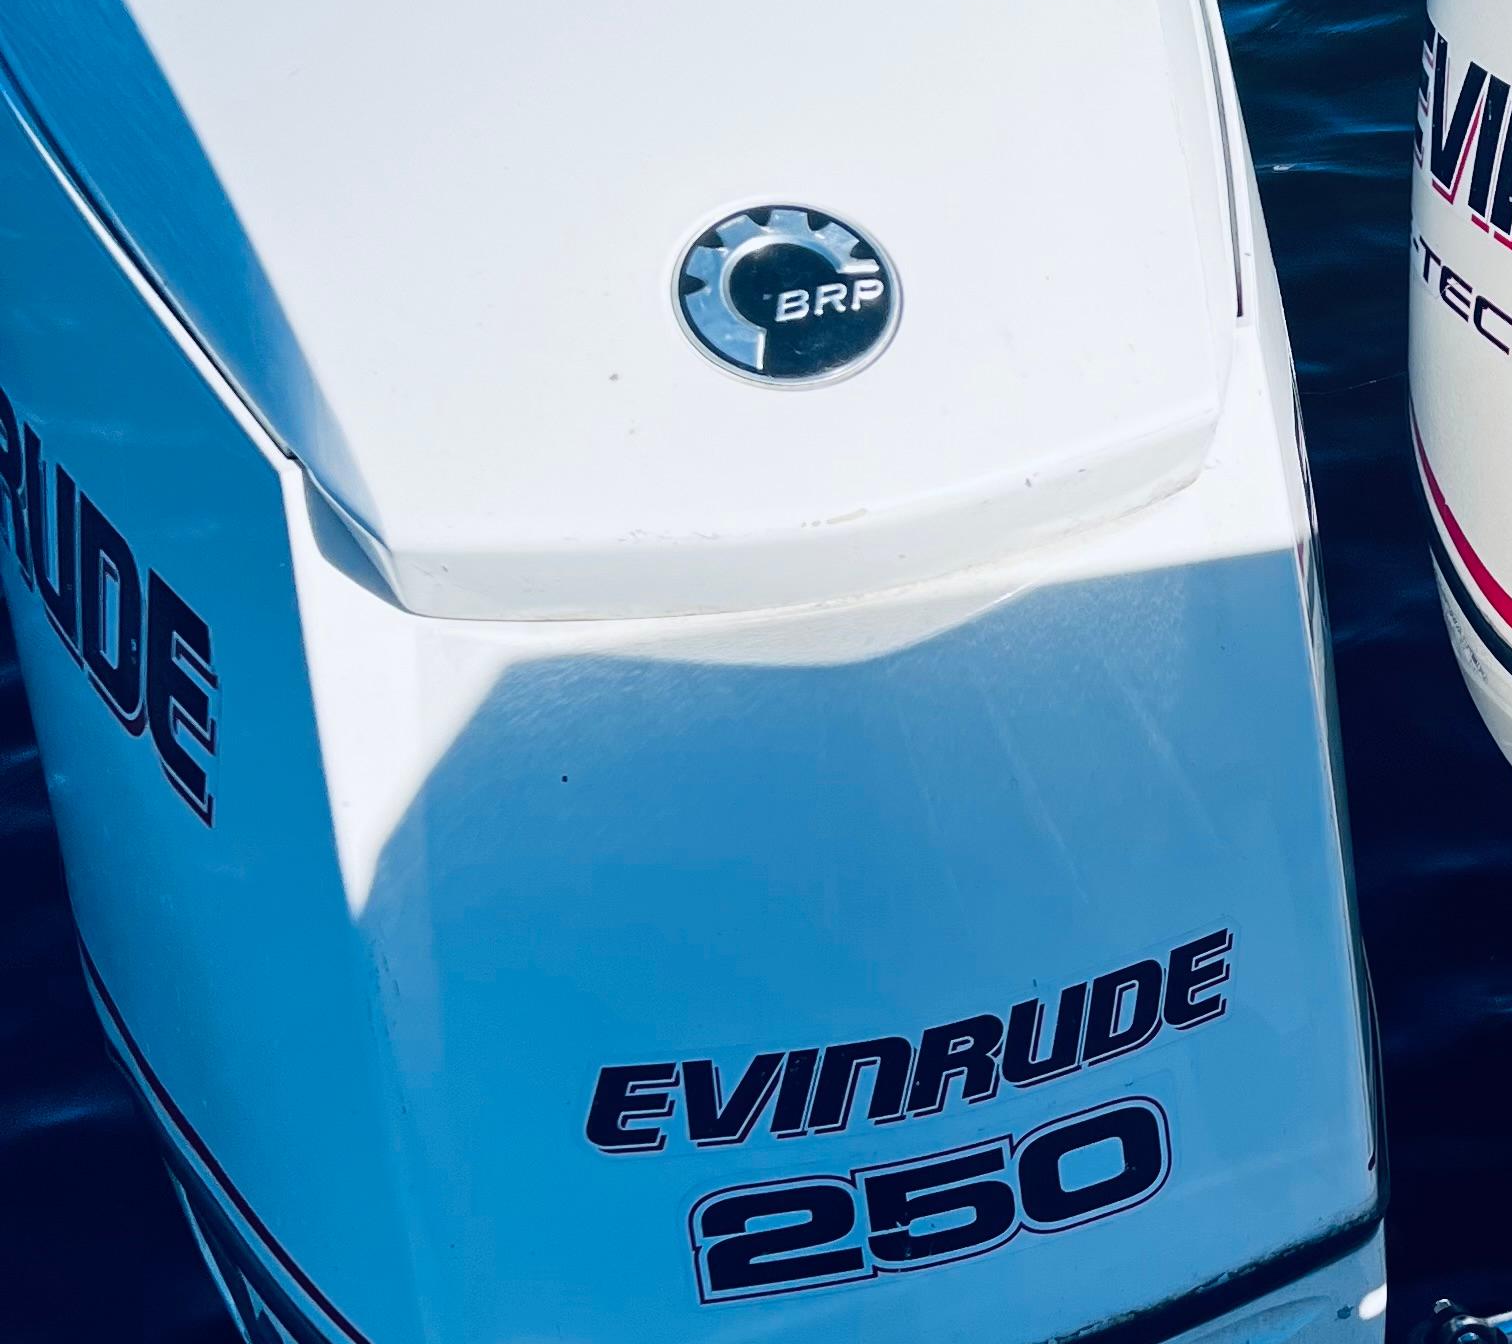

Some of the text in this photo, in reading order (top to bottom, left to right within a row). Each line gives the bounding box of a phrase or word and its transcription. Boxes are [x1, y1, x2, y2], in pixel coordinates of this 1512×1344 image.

[775, 278, 885, 323] BRP
[586, 927, 1233, 1154] EVINRUDE
[700, 1106, 1162, 1292] 250
